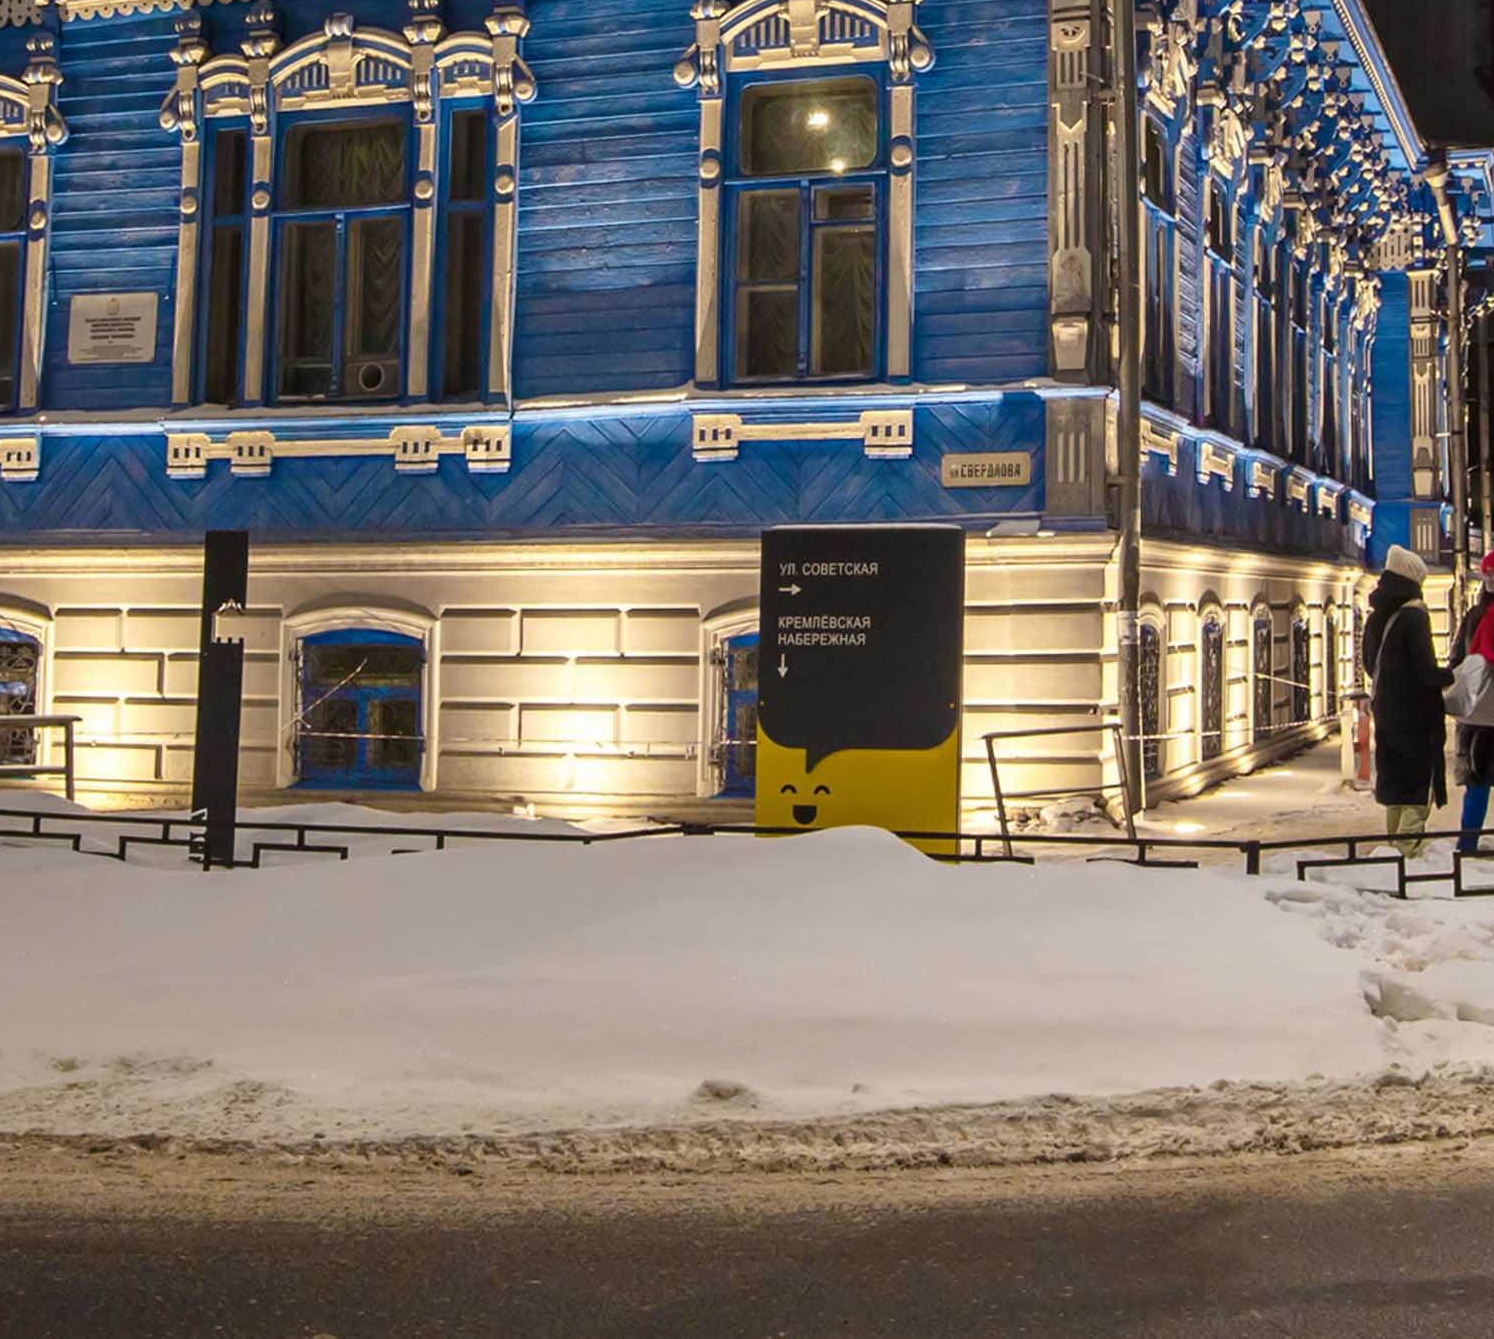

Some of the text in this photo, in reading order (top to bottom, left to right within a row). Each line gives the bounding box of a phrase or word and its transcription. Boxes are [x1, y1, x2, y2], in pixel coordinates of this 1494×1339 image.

[961, 462, 1021, 479] СВЕРДЛОВА
[779, 562, 879, 576] УЛ. СОВЕТСКАЯ
[777, 613, 872, 629] КРЕМЛЁВСКАЯ
[777, 632, 867, 646] НАБЕРЕЖНАЯ
